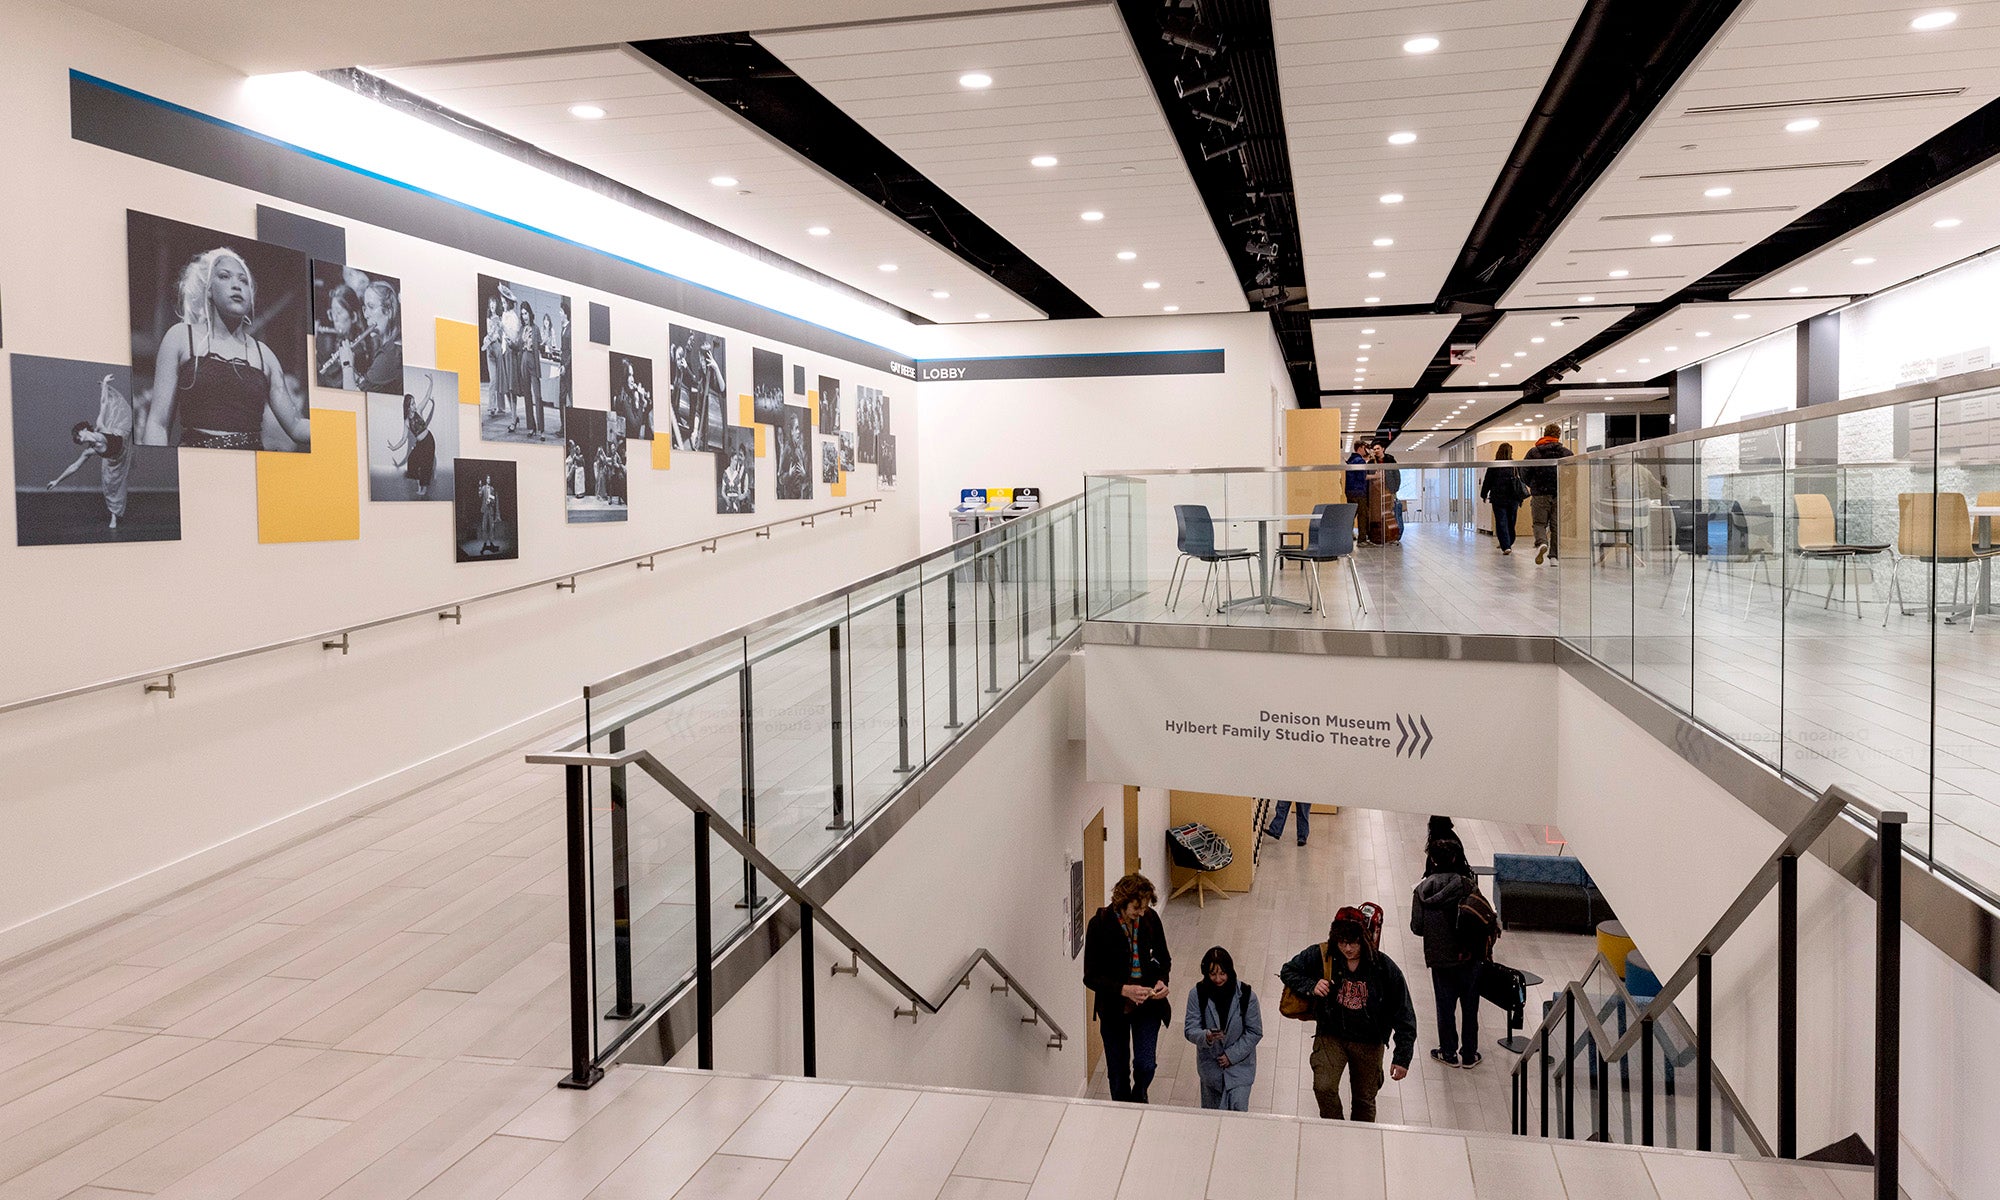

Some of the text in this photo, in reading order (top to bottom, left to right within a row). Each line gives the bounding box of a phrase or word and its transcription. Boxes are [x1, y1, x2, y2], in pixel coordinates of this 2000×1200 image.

[923, 367, 966, 379] LOBBY
[1259, 710, 1391, 731] Denison Museum
[1165, 720, 1391, 748] Hylbert Family Studio Theatre
